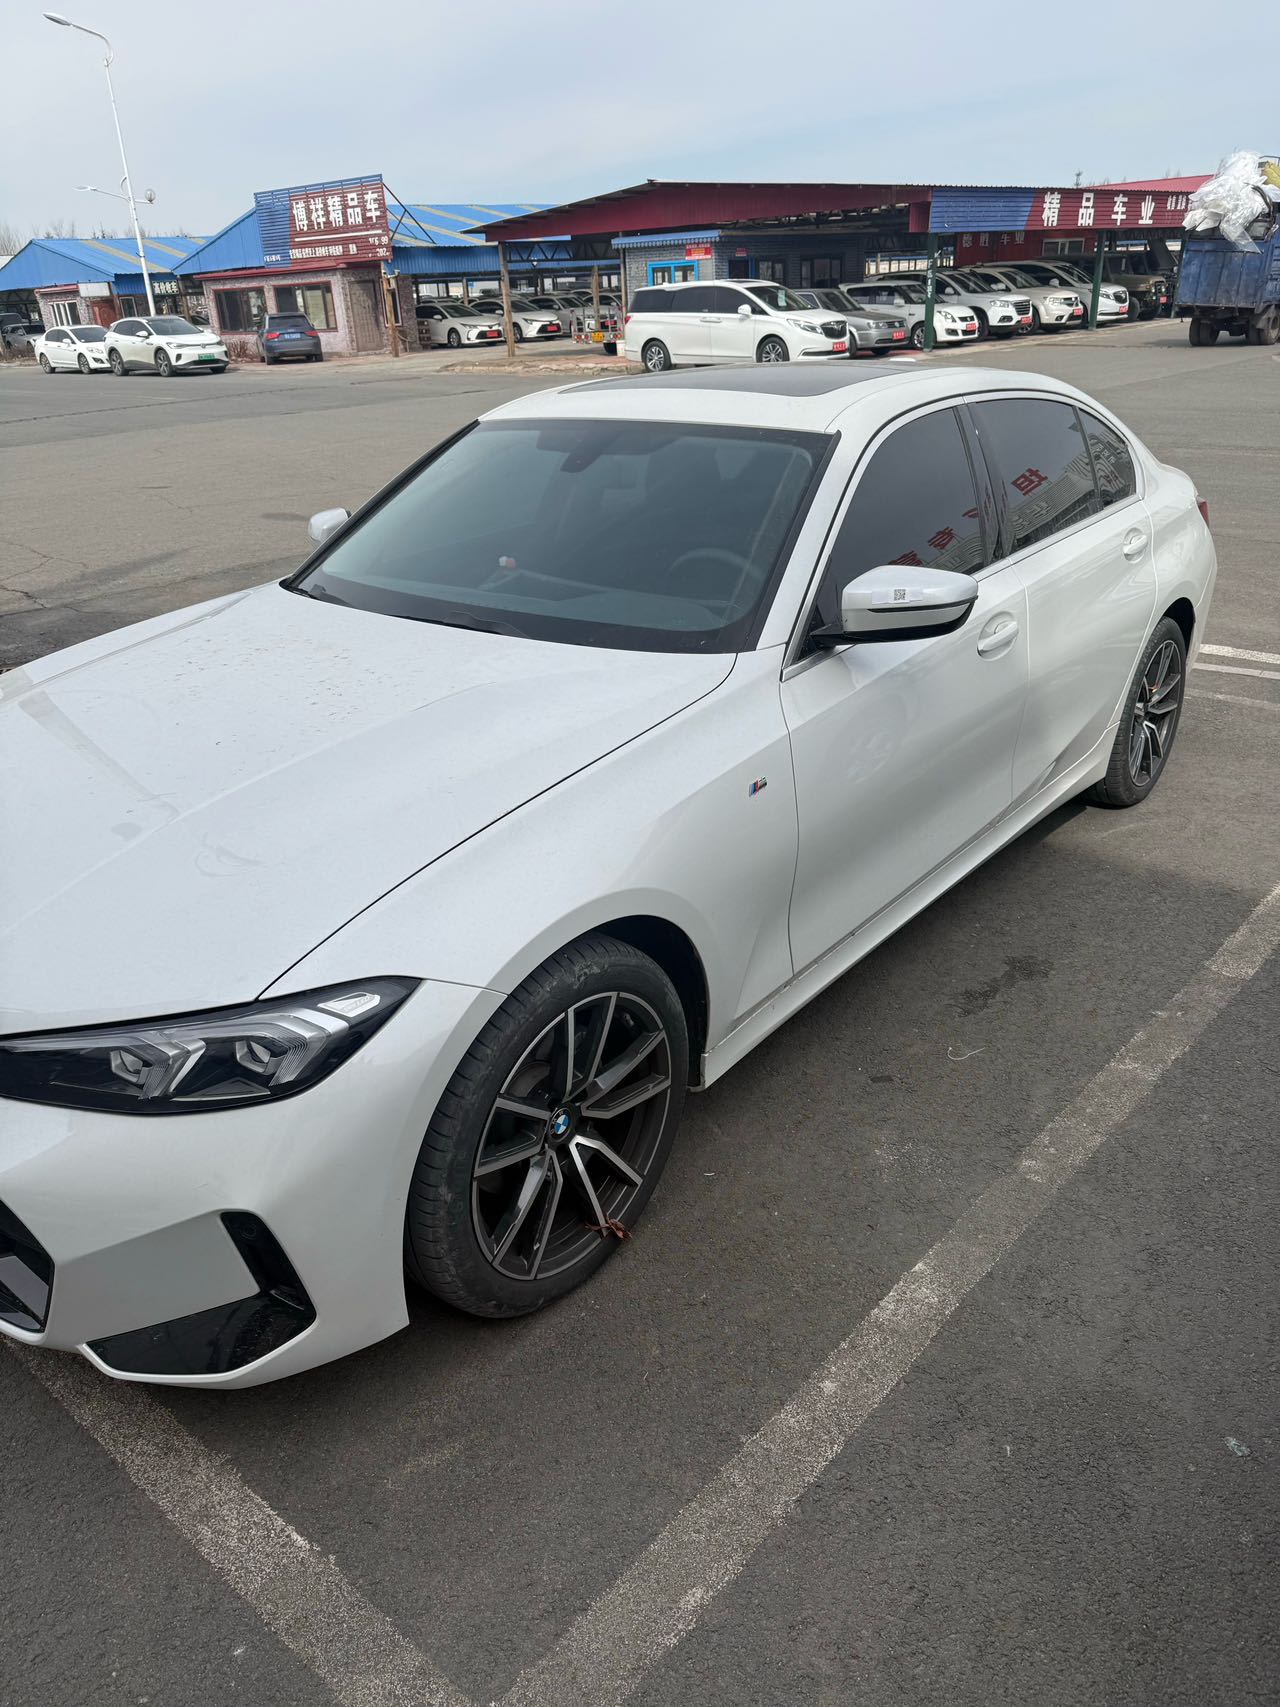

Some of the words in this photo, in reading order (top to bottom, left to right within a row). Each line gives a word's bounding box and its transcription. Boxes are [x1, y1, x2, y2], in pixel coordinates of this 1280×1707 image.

[292, 191, 381, 232] 博祥精品车
[1041, 191, 1155, 227] 精品车业
